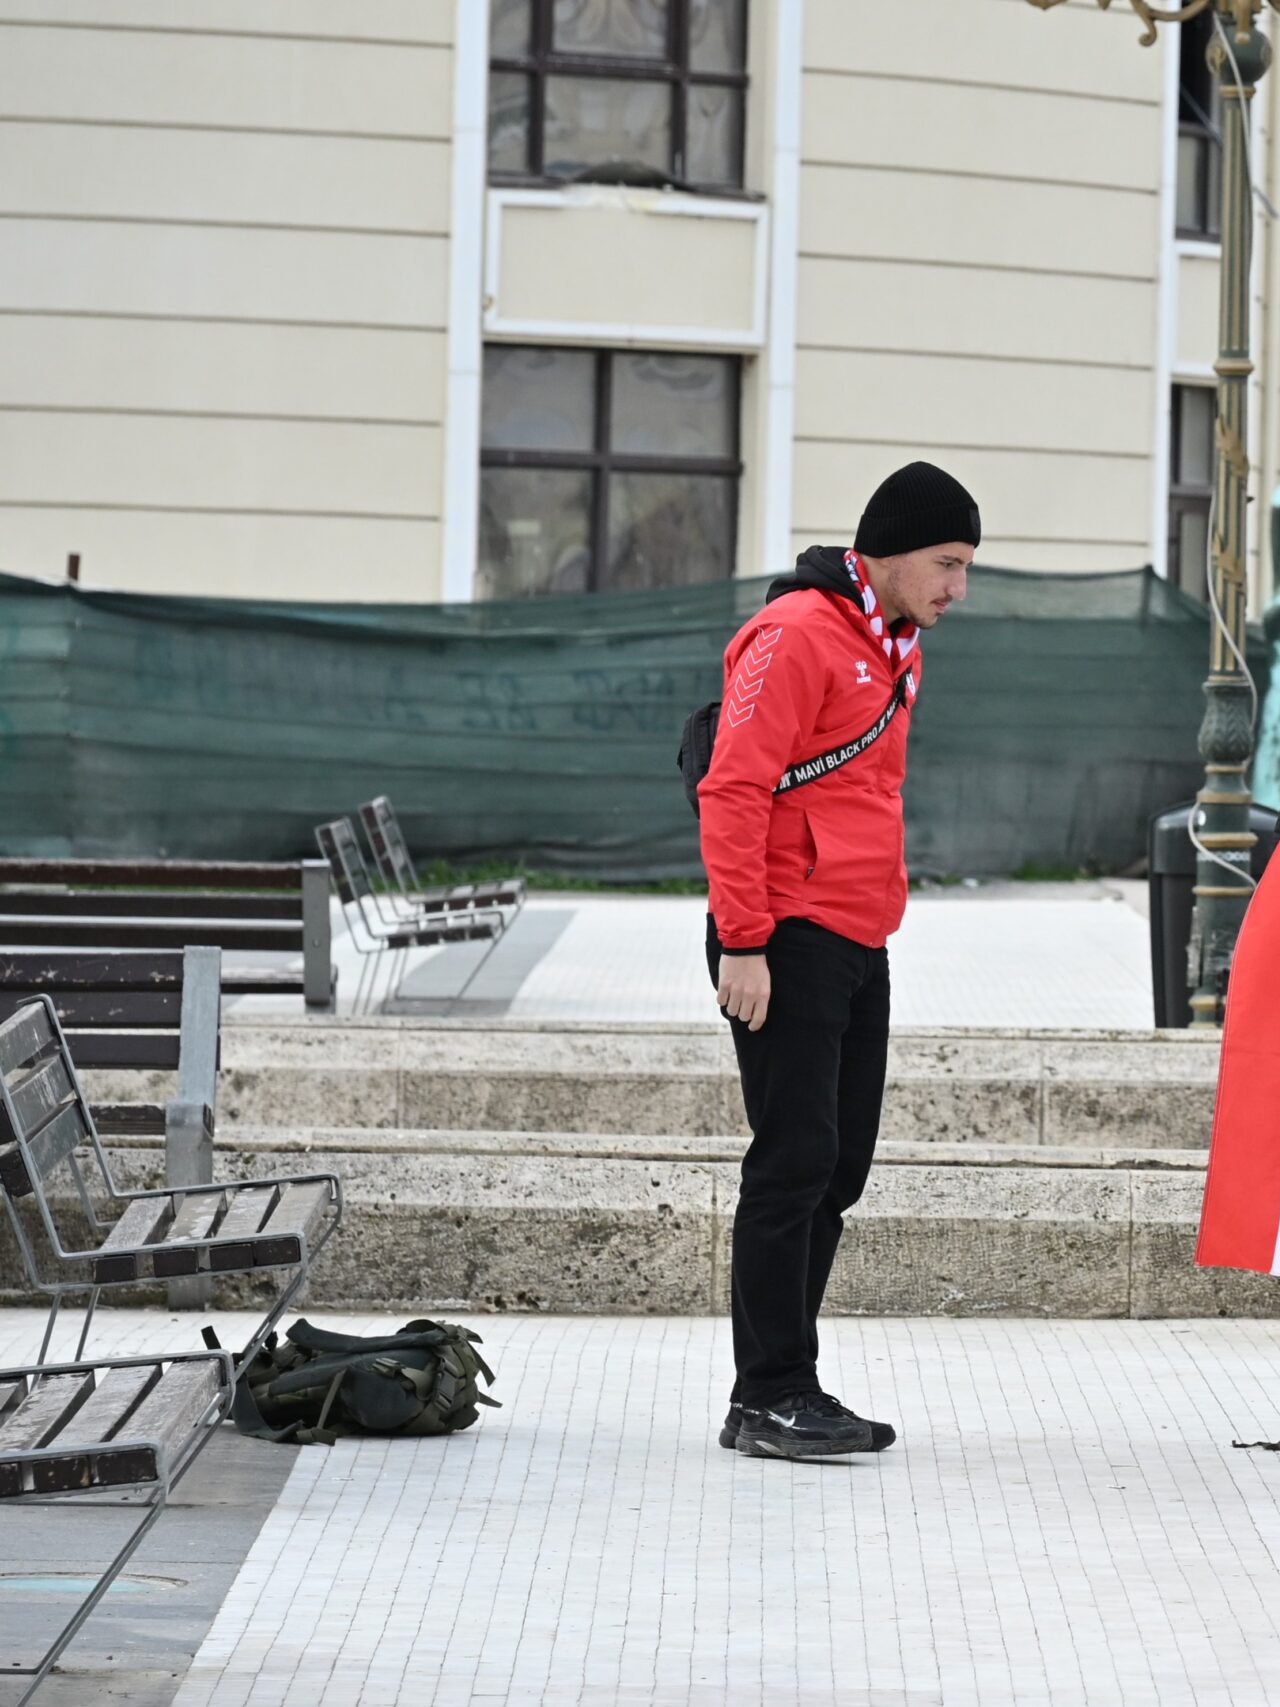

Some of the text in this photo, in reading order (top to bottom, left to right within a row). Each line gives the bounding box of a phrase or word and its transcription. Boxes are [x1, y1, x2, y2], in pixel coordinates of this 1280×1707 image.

[794, 756, 826, 783] MAVİ
[825, 741, 861, 770] BLACK
[861, 726, 878, 749] PRO
